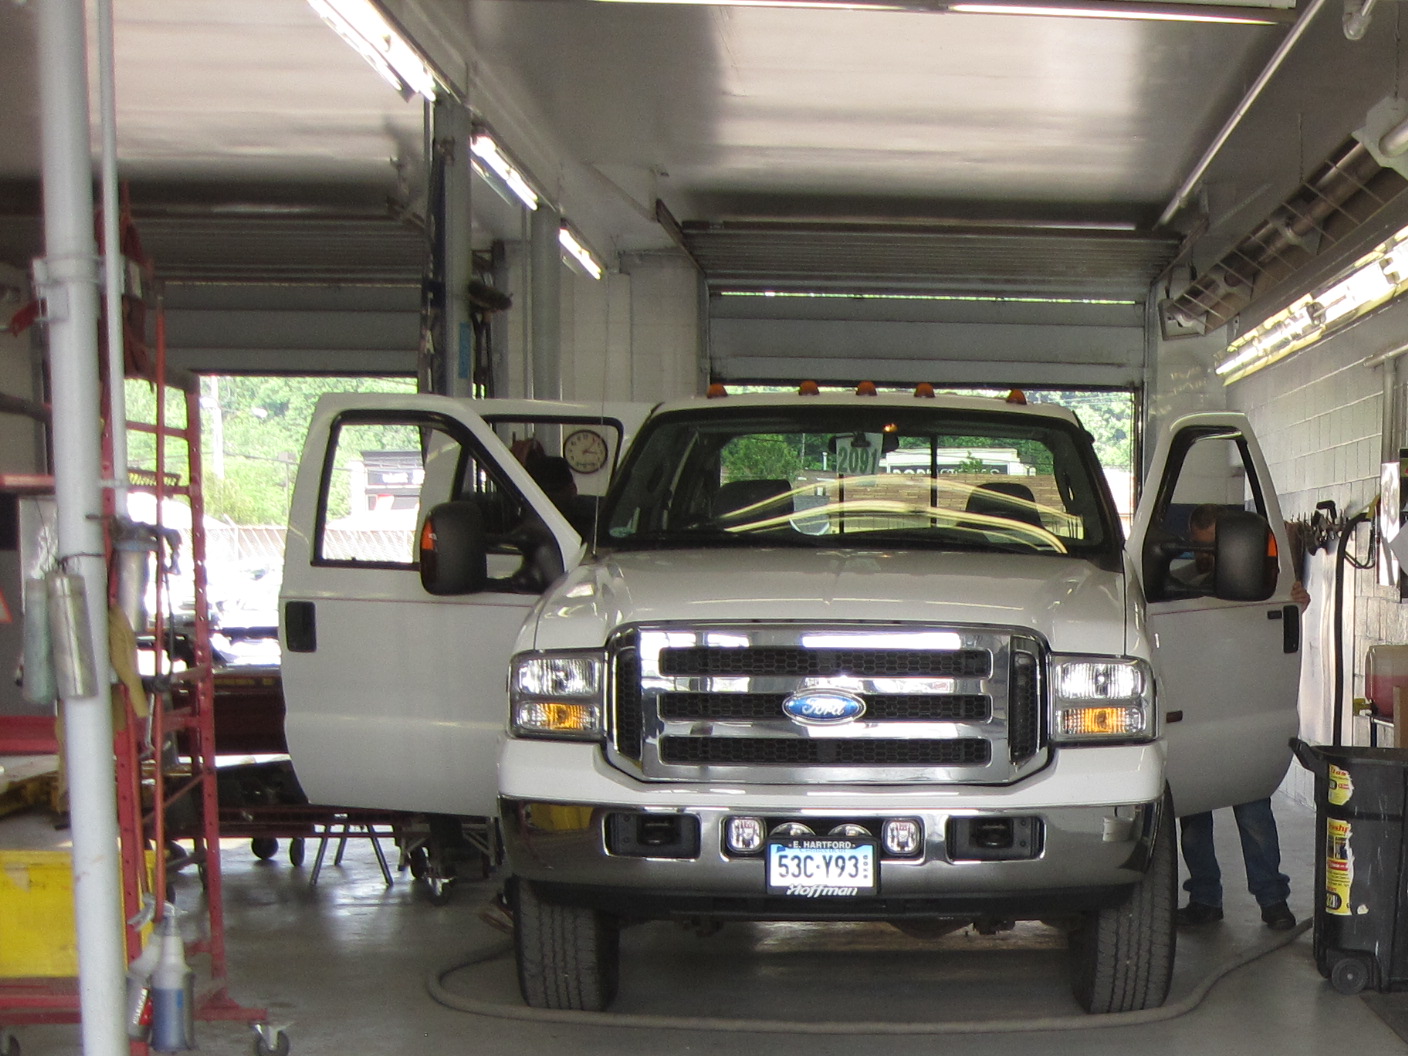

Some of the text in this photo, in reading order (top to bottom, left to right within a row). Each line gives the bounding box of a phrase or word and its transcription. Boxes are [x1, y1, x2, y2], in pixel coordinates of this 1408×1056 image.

[838, 447, 877, 474] 2091
[802, 697, 847, 716] Ford
[793, 841, 852, 850] E. HARTFORD
[787, 884, 858, 898] Hoffman
